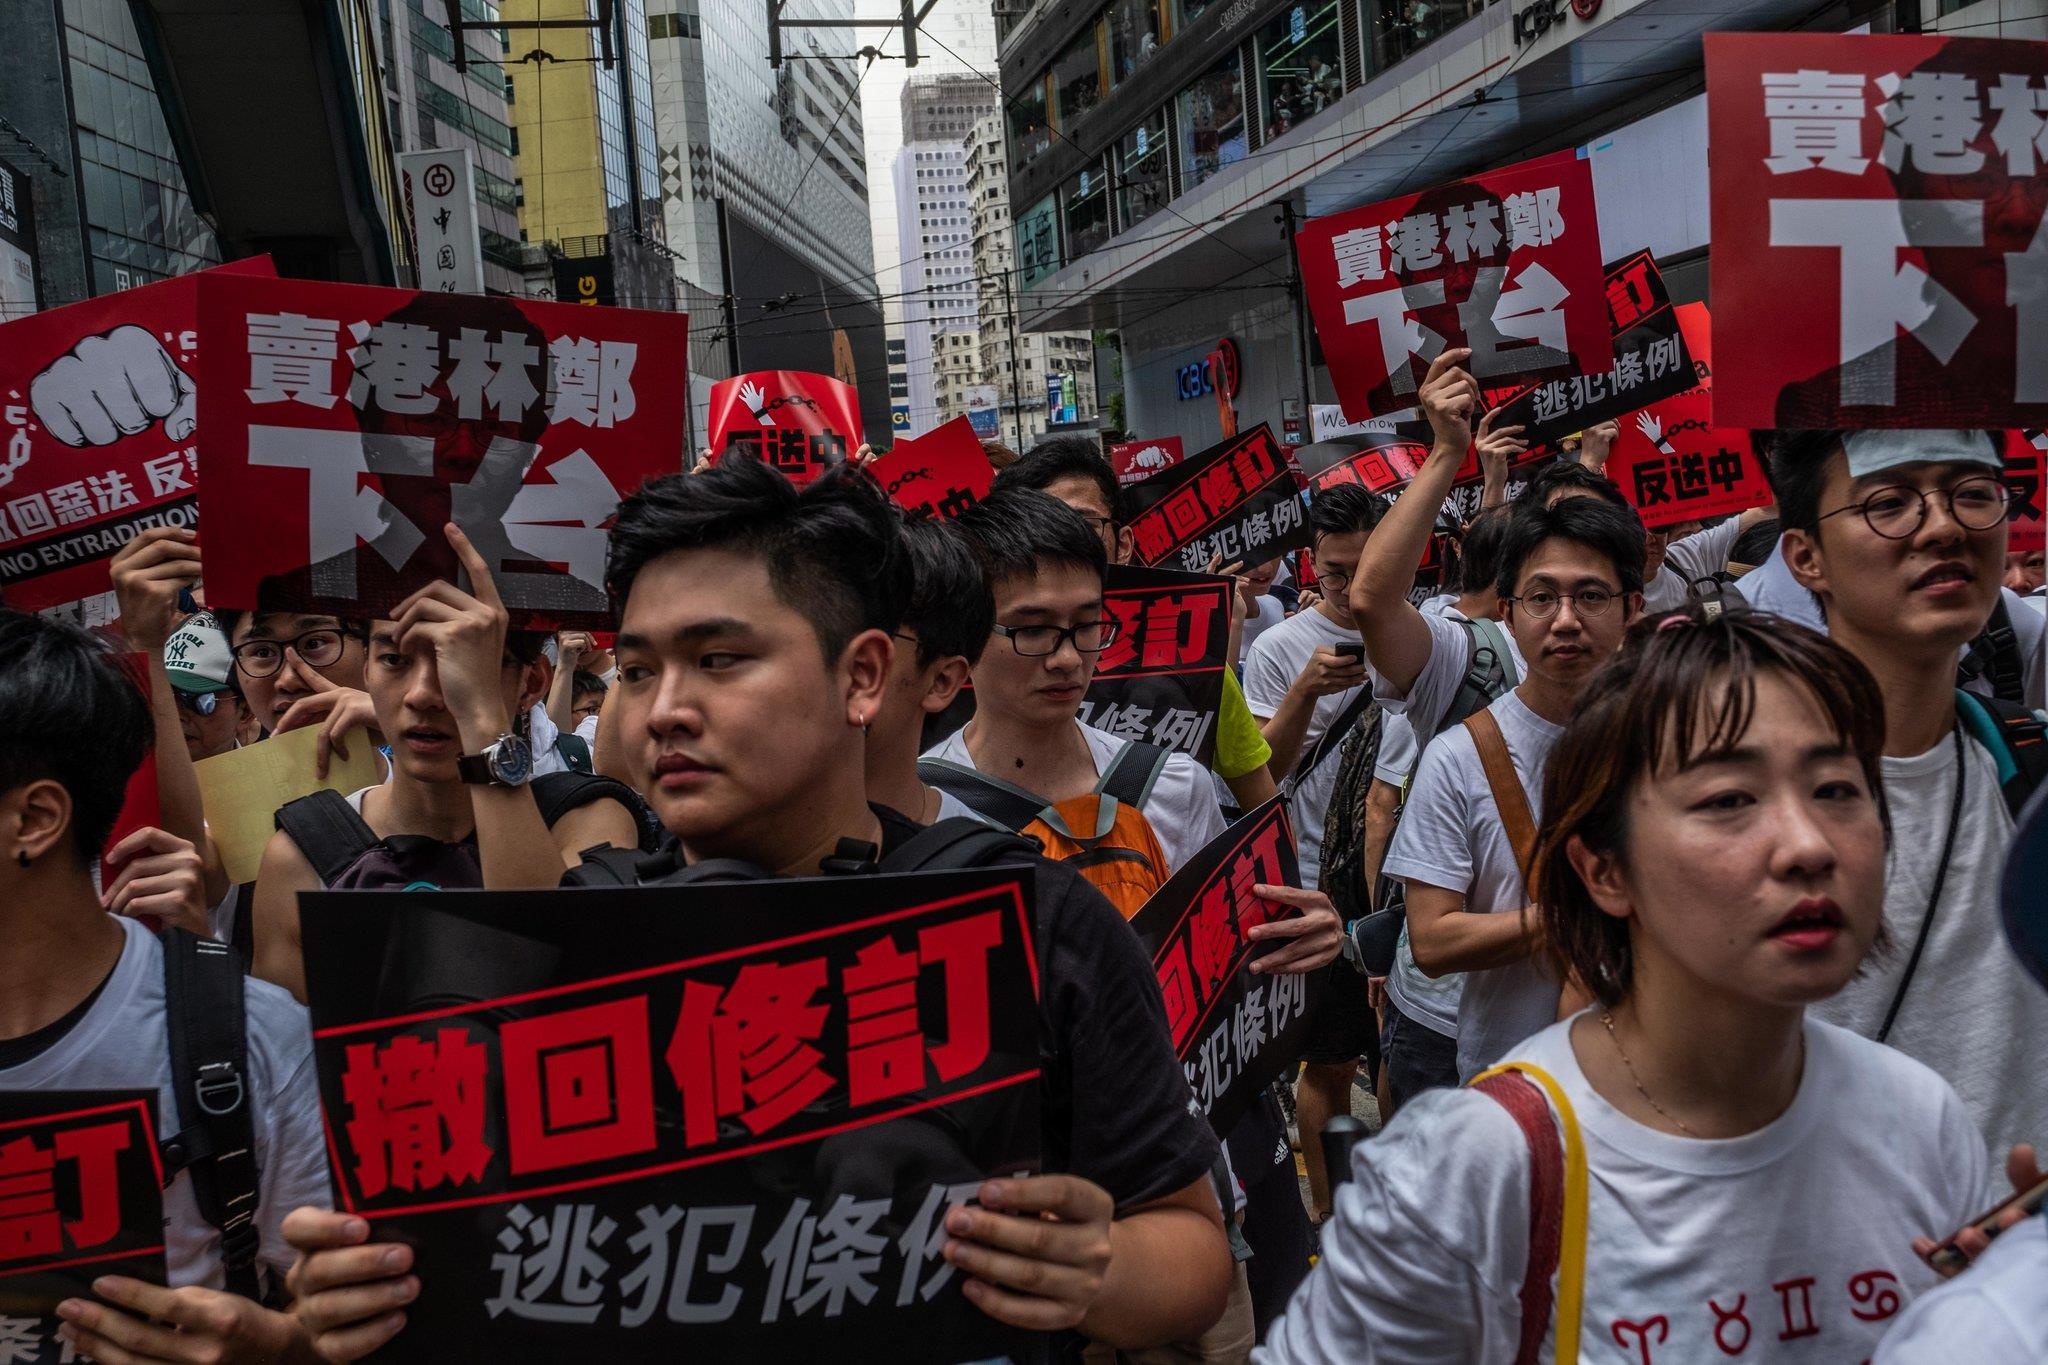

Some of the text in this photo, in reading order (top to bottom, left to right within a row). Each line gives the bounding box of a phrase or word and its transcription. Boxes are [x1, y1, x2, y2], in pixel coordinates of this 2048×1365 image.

[1331, 186, 1565, 289] 賣港林鄭
[1342, 261, 1571, 396] 下台
[1768, 198, 2048, 408] 下
[244, 311, 638, 428] 賣港林鄭
[1322, 411, 1346, 428] We
[1532, 332, 1682, 425] 逃犯條例
[247, 424, 624, 612] 下台
[1132, 434, 1275, 563] 撤回修訂
[1632, 448, 1744, 508] 反送中
[2003, 456, 2048, 522] 反
[0, 552, 38, 577] NO
[1181, 493, 1303, 573] 逃犯條例
[1075, 702, 1215, 758] 條例
[343, 909, 1004, 1199] 撤回修訂
[1185, 973, 1306, 1113] 犯條例
